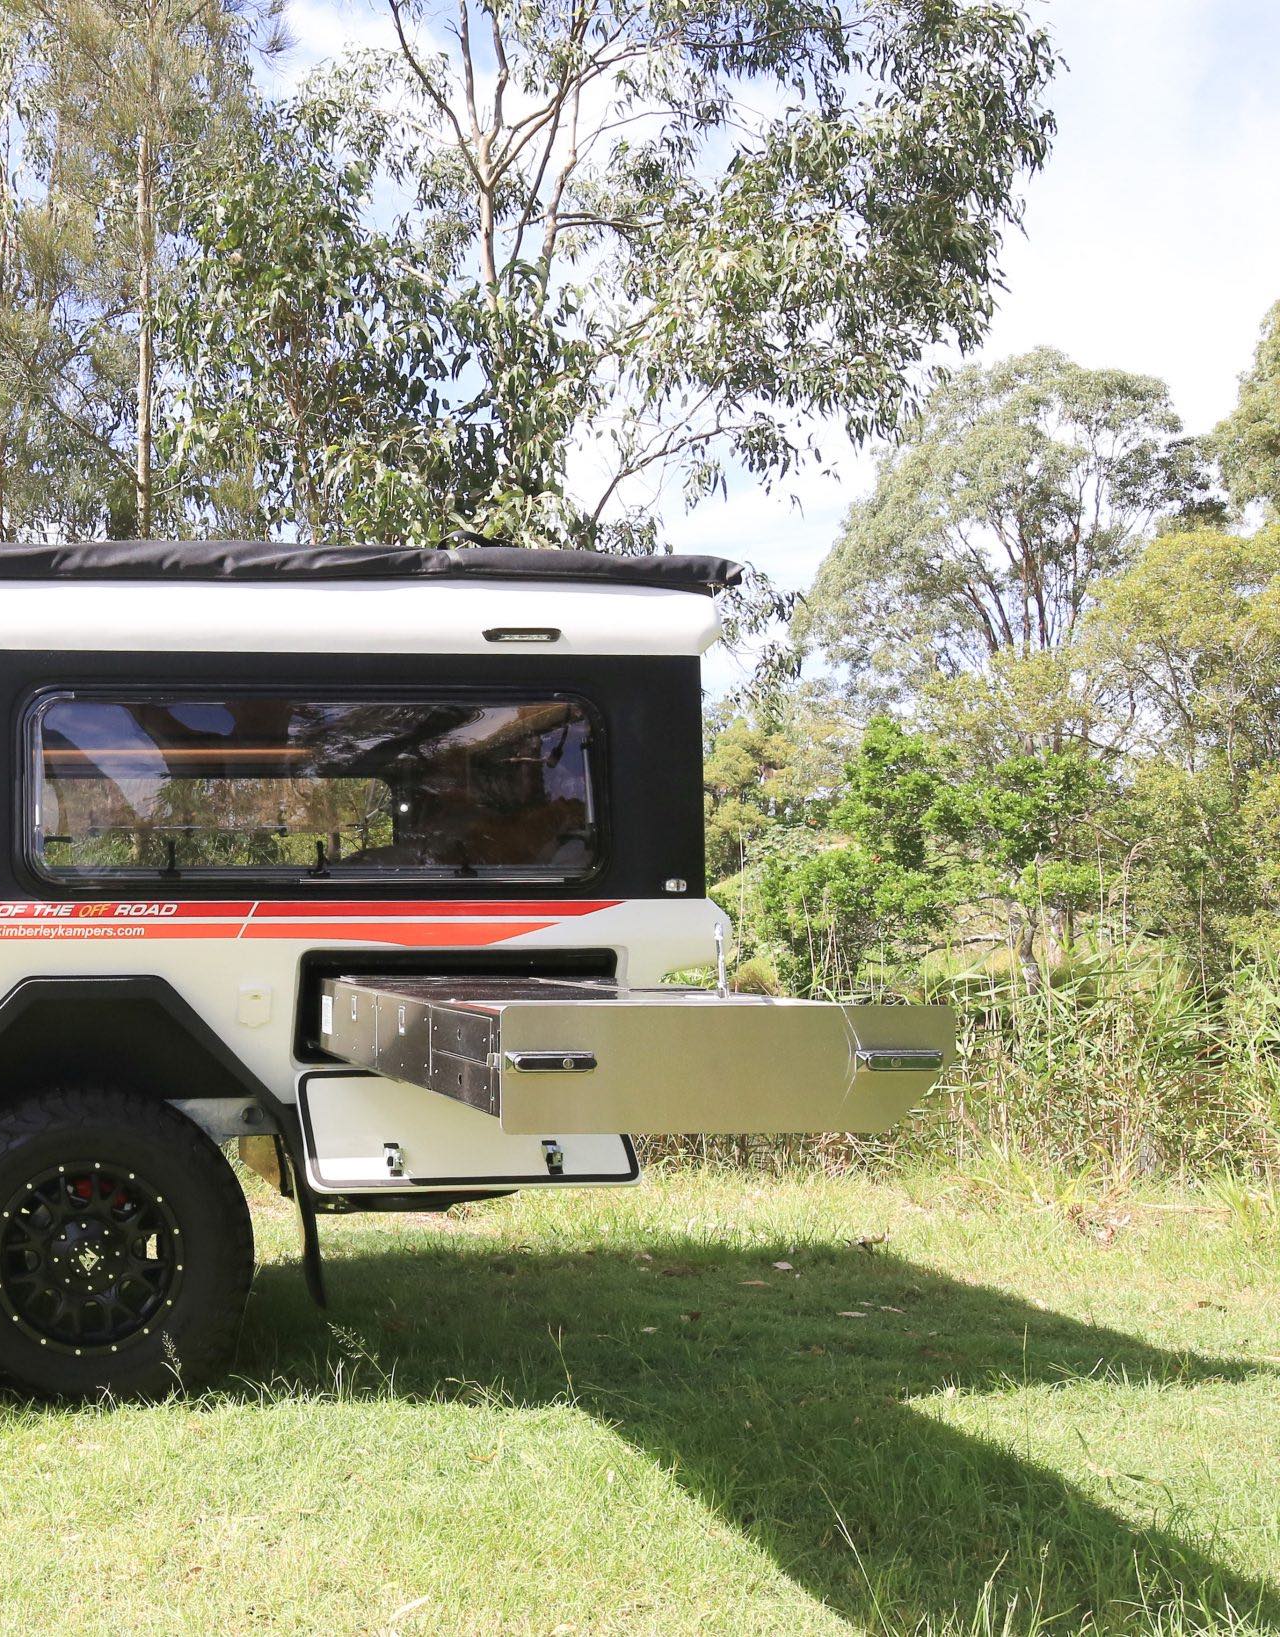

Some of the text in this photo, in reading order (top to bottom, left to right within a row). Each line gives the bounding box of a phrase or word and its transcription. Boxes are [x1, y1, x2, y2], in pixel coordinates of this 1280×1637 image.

[33, 904, 75, 917] THE
[78, 903, 112, 918] OFF
[114, 903, 178, 916] ROAD
